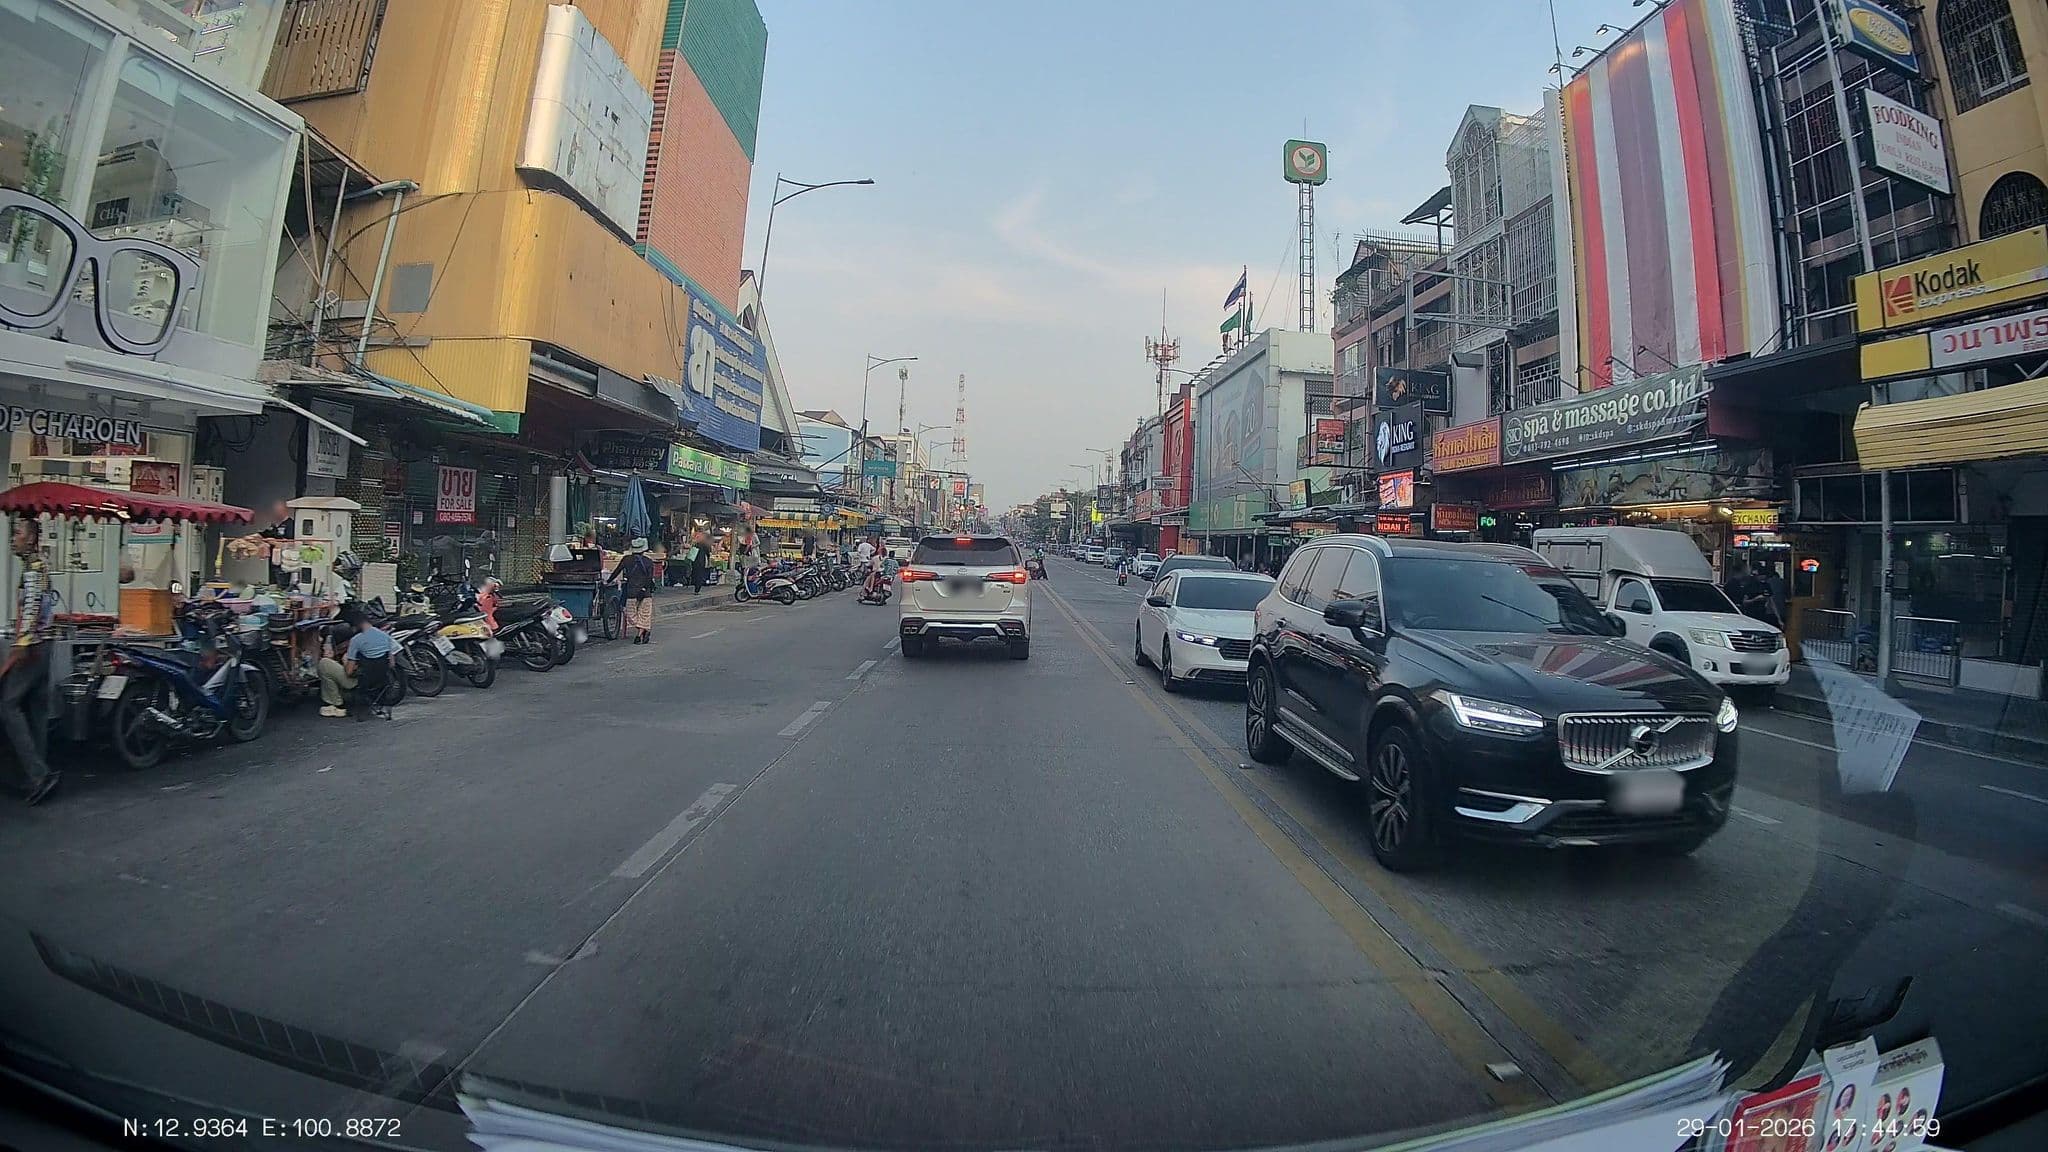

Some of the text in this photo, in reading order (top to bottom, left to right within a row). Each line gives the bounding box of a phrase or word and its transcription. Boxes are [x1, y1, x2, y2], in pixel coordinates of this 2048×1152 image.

[1872, 105, 1939, 150] FOODKING
[1914, 258, 1981, 297] Kodak
[1918, 284, 1986, 310] express
[1411, 382, 1440, 395] KING
[1524, 374, 1696, 442] spa & massage co.ltd
[30, 409, 141, 444] CHAROEN
[1393, 421, 1414, 445] KING
[441, 468, 473, 497] ขาย
[440, 497, 473, 511] FOR SALE
[1732, 514, 1777, 524] EXCHANGE
